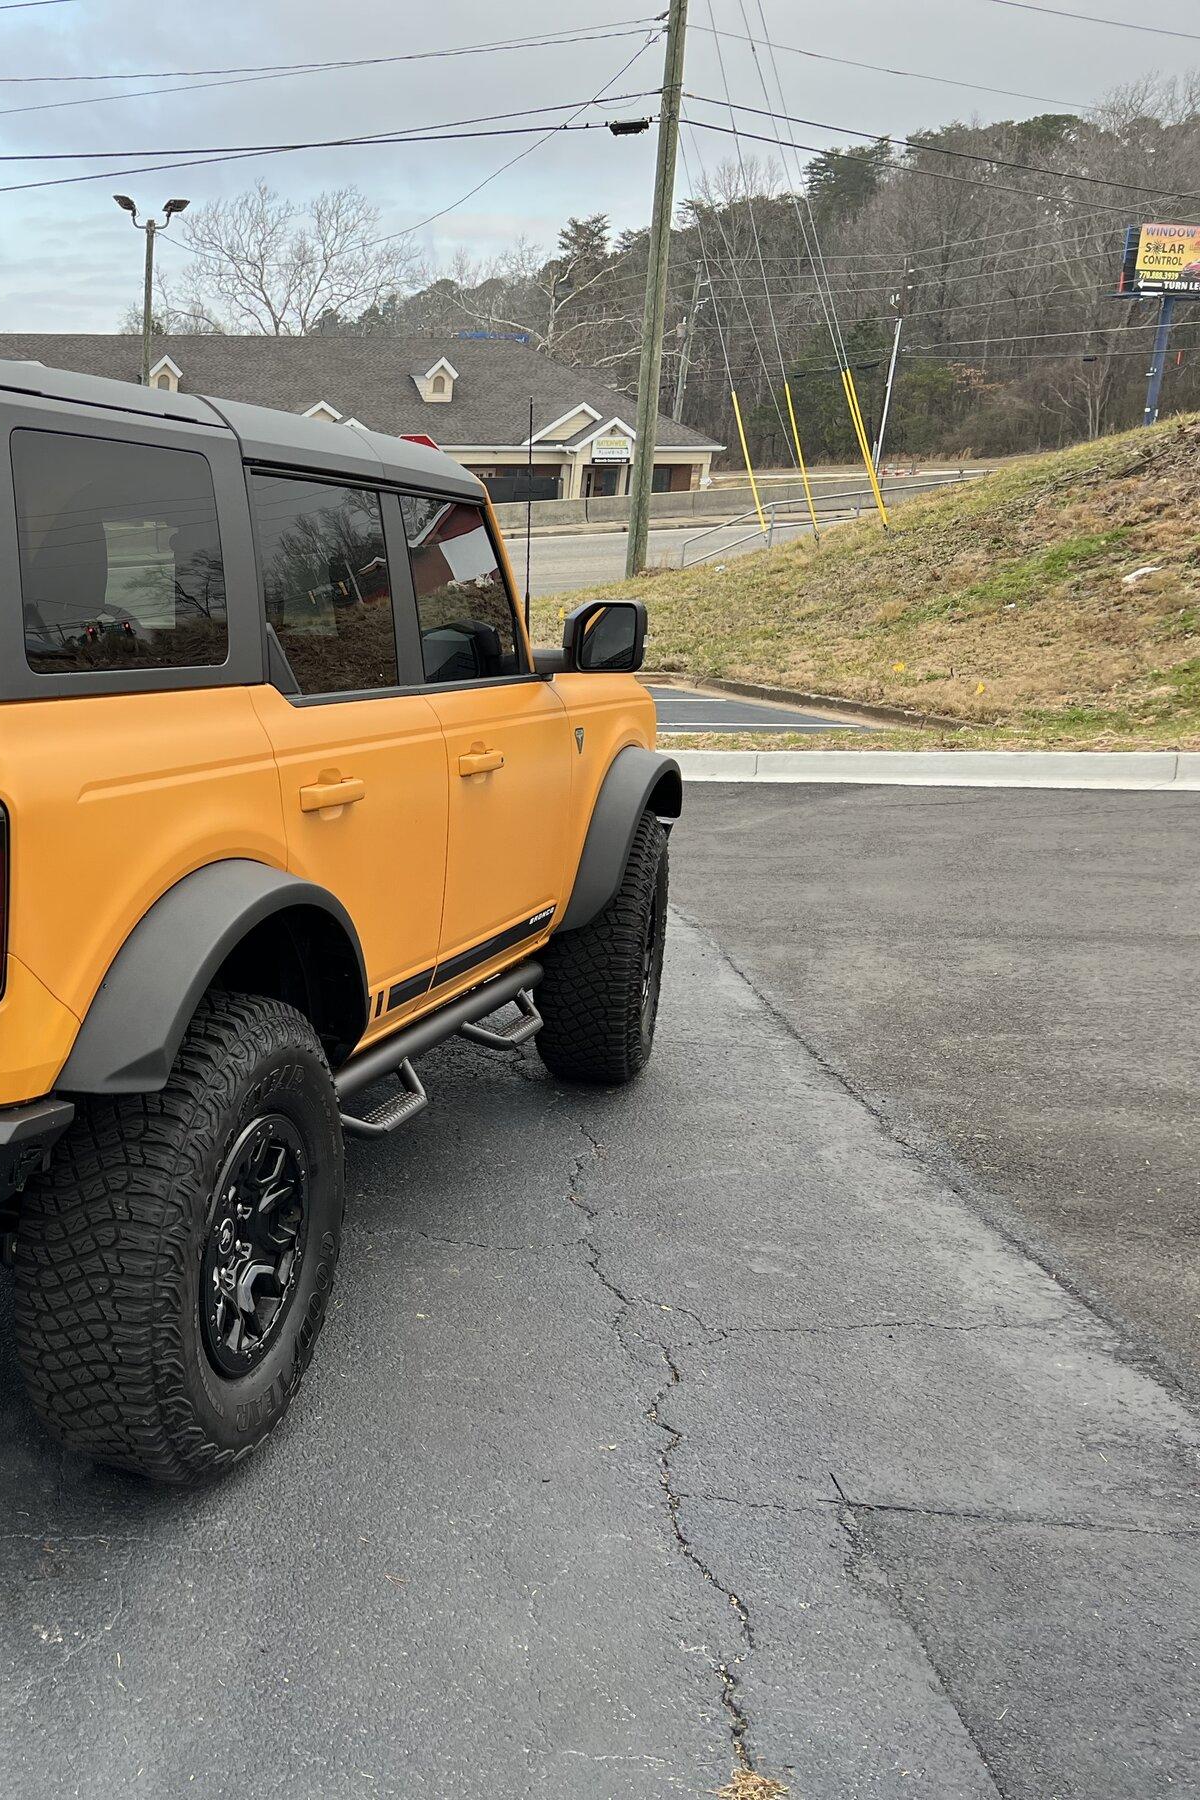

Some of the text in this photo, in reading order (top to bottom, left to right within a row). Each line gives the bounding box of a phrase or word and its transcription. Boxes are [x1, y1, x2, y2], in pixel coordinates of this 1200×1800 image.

[1146, 227, 1196, 237] WINDOW
[1143, 255, 1183, 266] CONTROL
[1164, 281, 1200, 291] TURN LE
[529, 906, 555, 925] BRONCO
